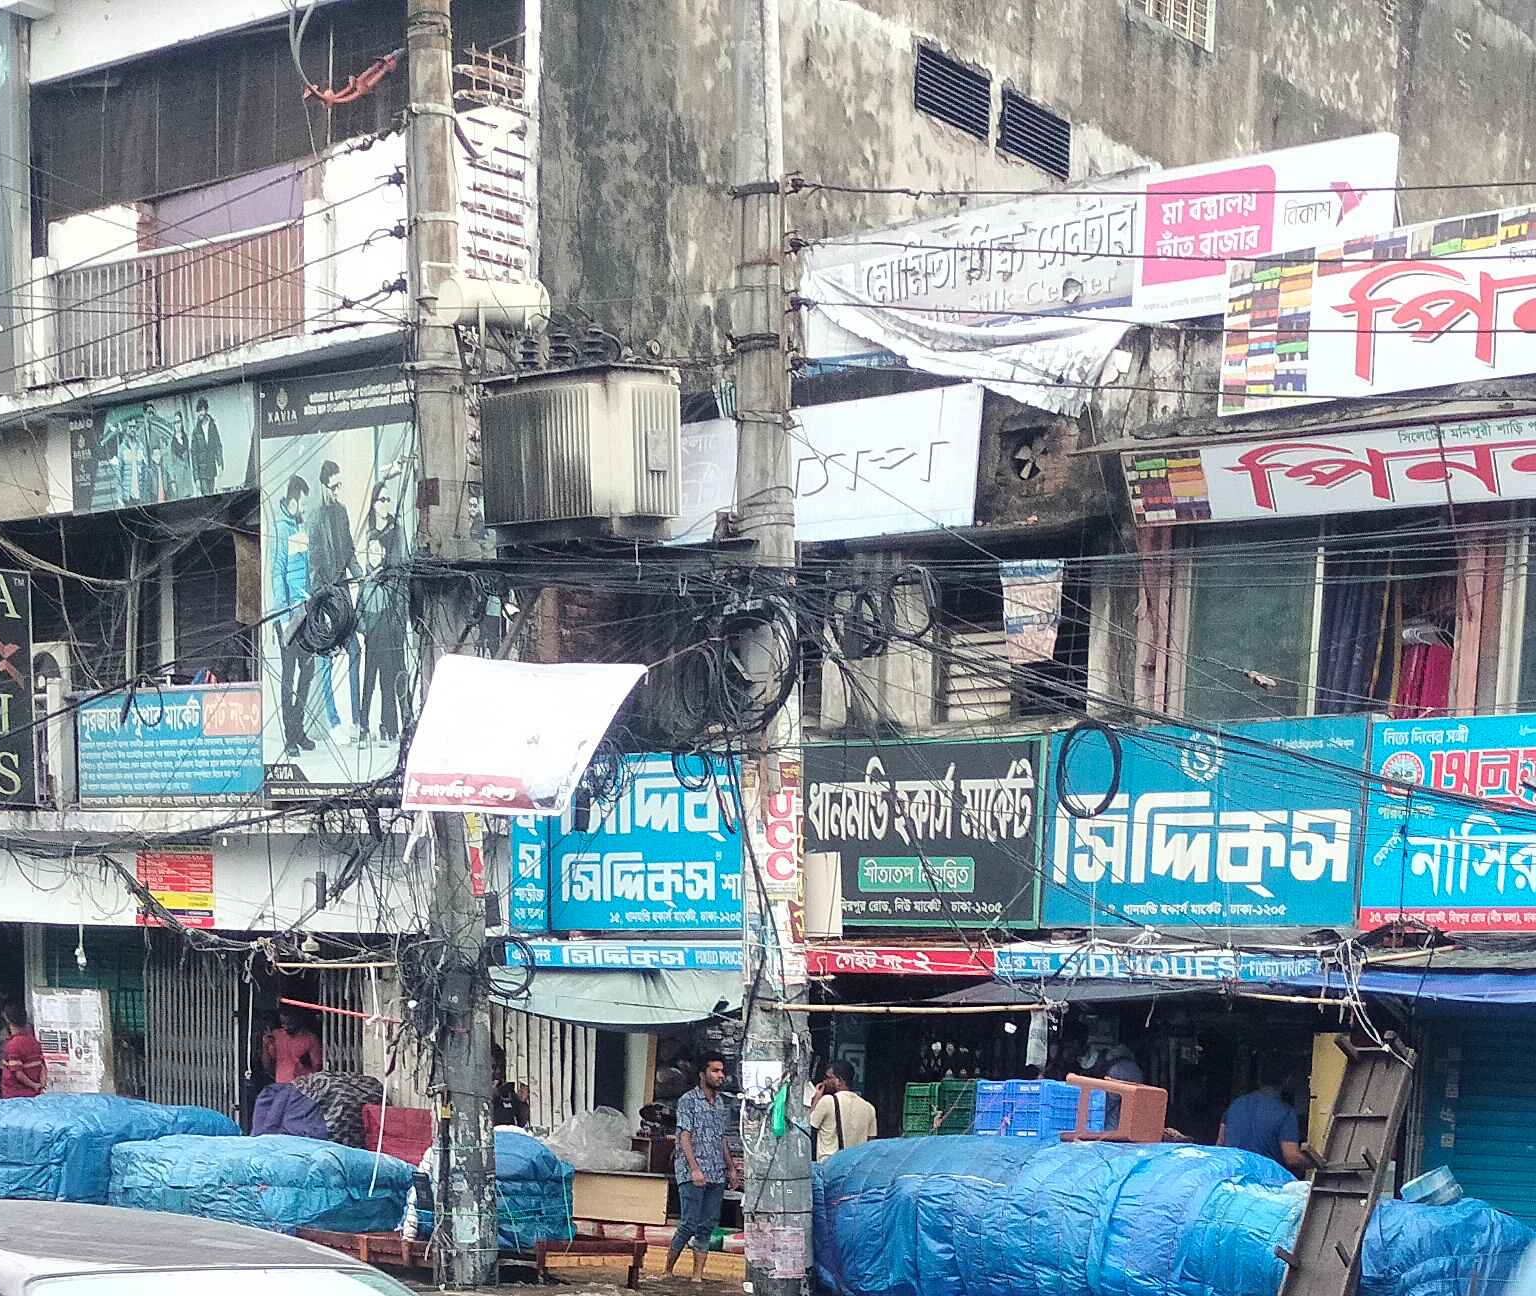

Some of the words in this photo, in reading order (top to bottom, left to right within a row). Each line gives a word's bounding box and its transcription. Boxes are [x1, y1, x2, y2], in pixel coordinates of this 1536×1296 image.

[1161, 199, 1183, 226] মা
[1187, 192, 1258, 223] বস্ত্রালয়
[1283, 199, 1332, 226] বিকাশ
[1199, 224, 1261, 258] বাজার
[1383, 727, 1409, 746] নিত্য
[1411, 726, 1444, 745] দিনের
[894, 762, 955, 846] হকার্স
[960, 758, 1035, 842] মার্কেট
[766, 790, 796, 881] UCC
[863, 859, 915, 885] শীতাতপ
[894, 897, 912, 913] নিউ
